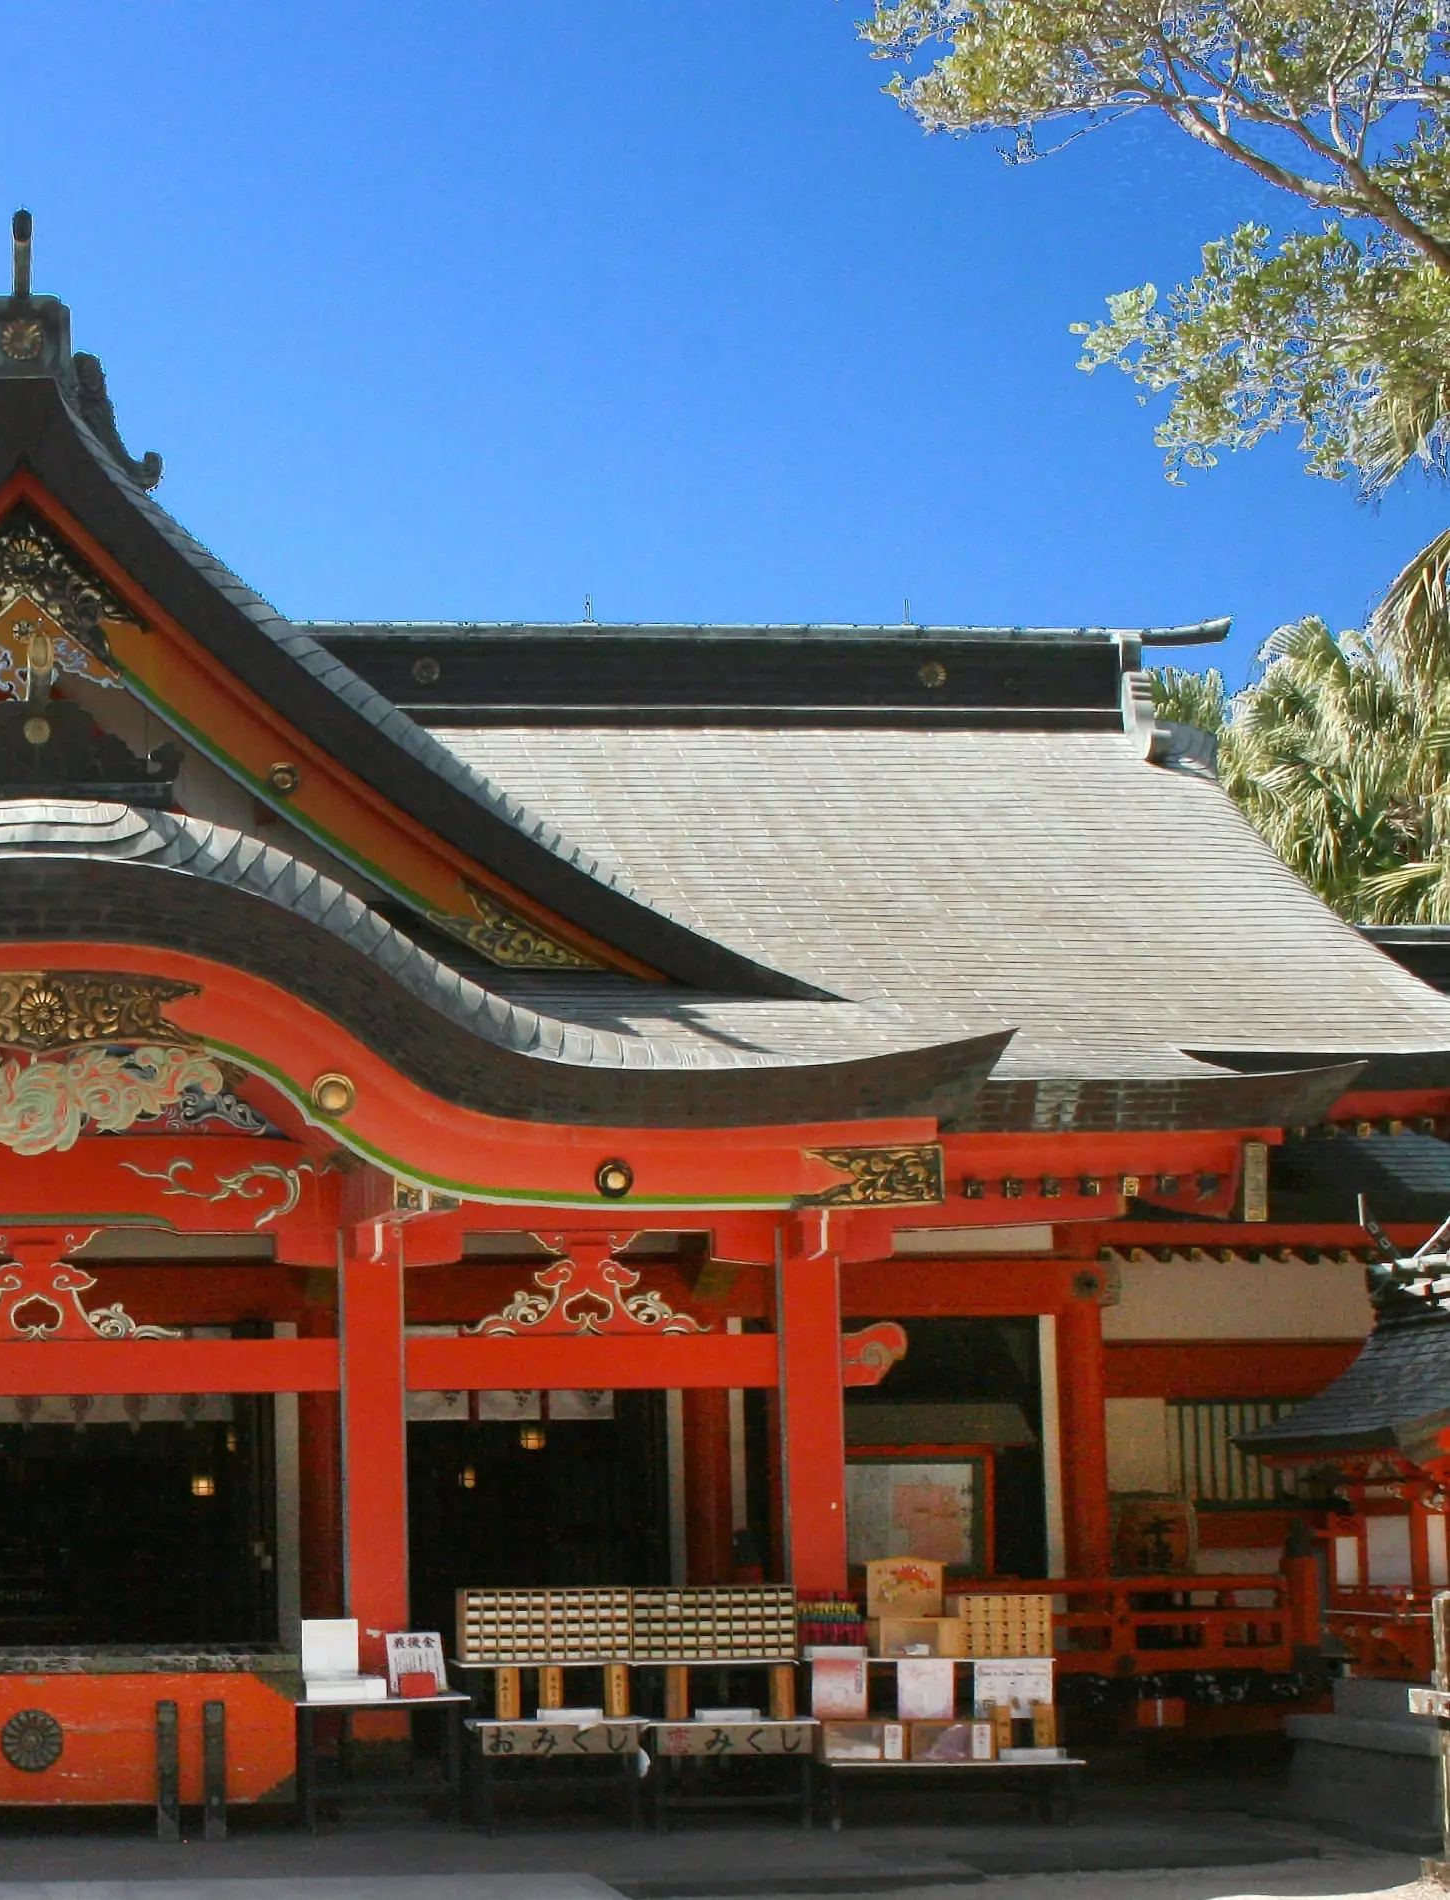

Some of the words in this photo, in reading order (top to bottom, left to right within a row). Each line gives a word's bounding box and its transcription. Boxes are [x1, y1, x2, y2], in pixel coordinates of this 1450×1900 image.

[489, 1727, 630, 1755] おみくじ
[666, 1726, 802, 1755] 恋みくじ
